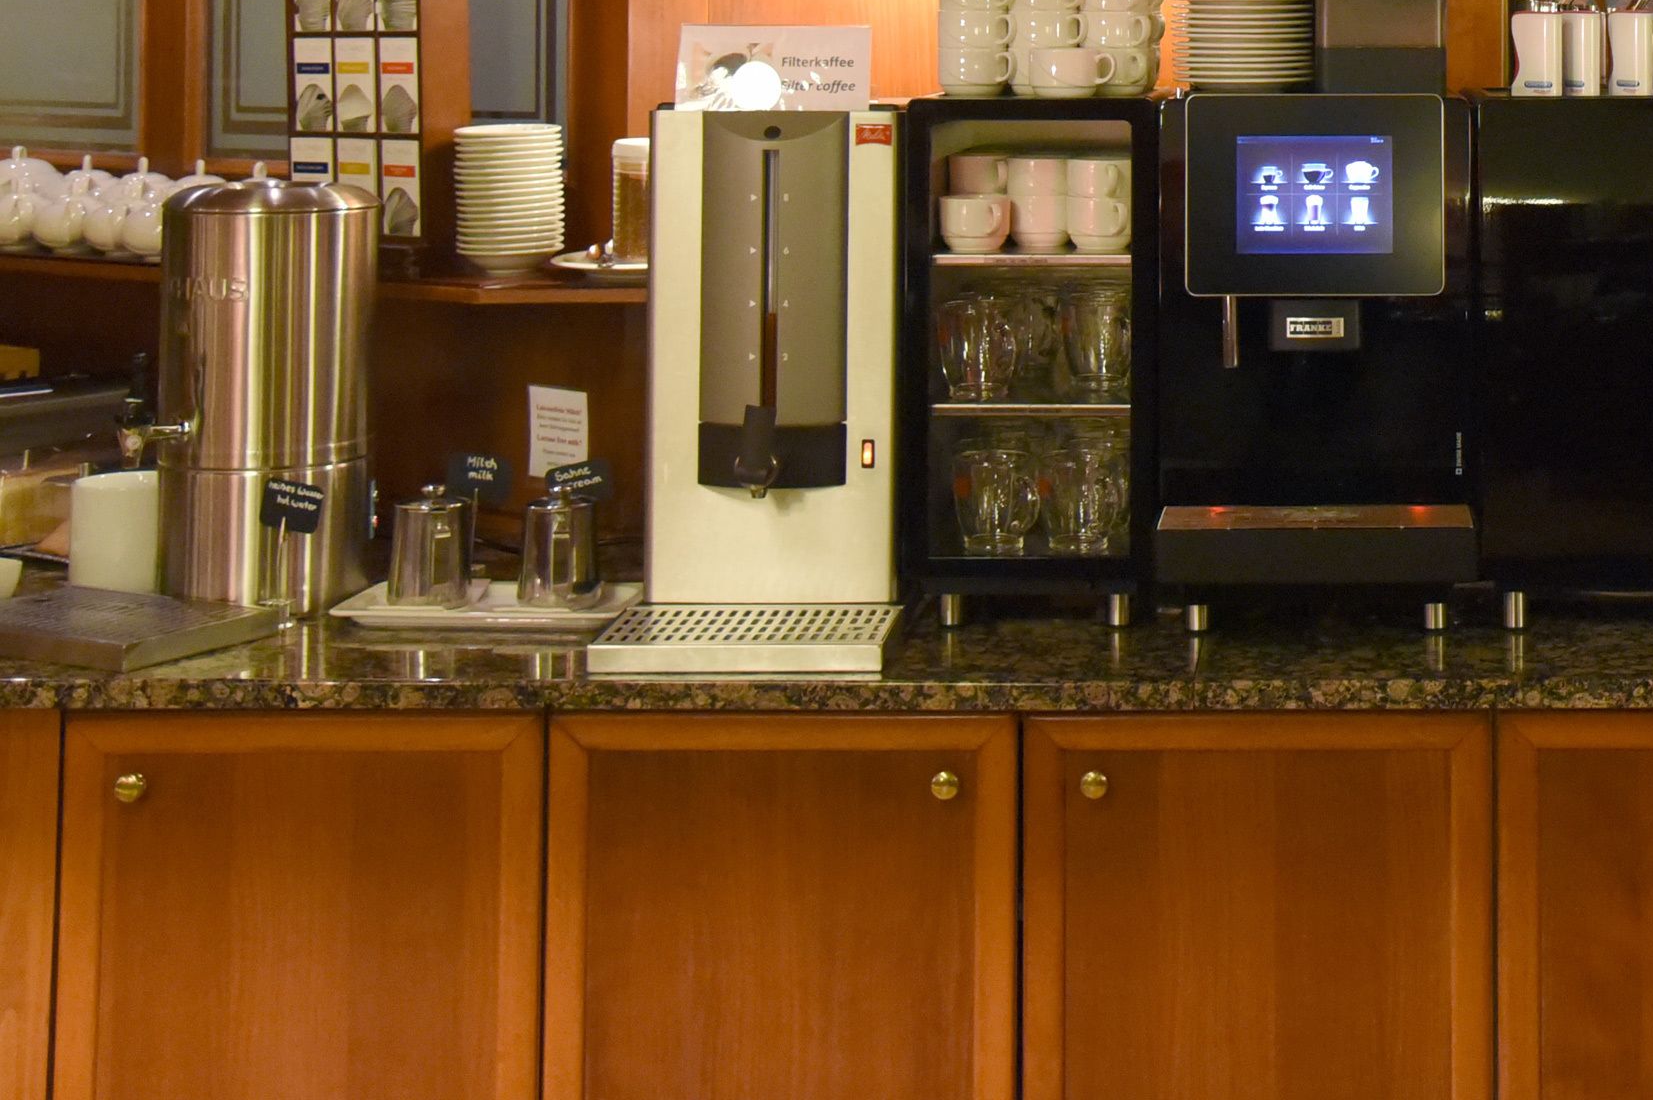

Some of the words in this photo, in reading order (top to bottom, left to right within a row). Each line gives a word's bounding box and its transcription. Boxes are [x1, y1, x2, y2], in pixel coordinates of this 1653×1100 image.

[781, 56, 855, 68] Filterkaffee
[816, 80, 856, 94] coffee
[783, 246, 790, 255] 6
[782, 299, 789, 308] 4
[1290, 323, 1332, 332] FRANKE
[466, 456, 498, 471] Milch
[467, 470, 494, 481] milk
[554, 466, 592, 482] Sahne
